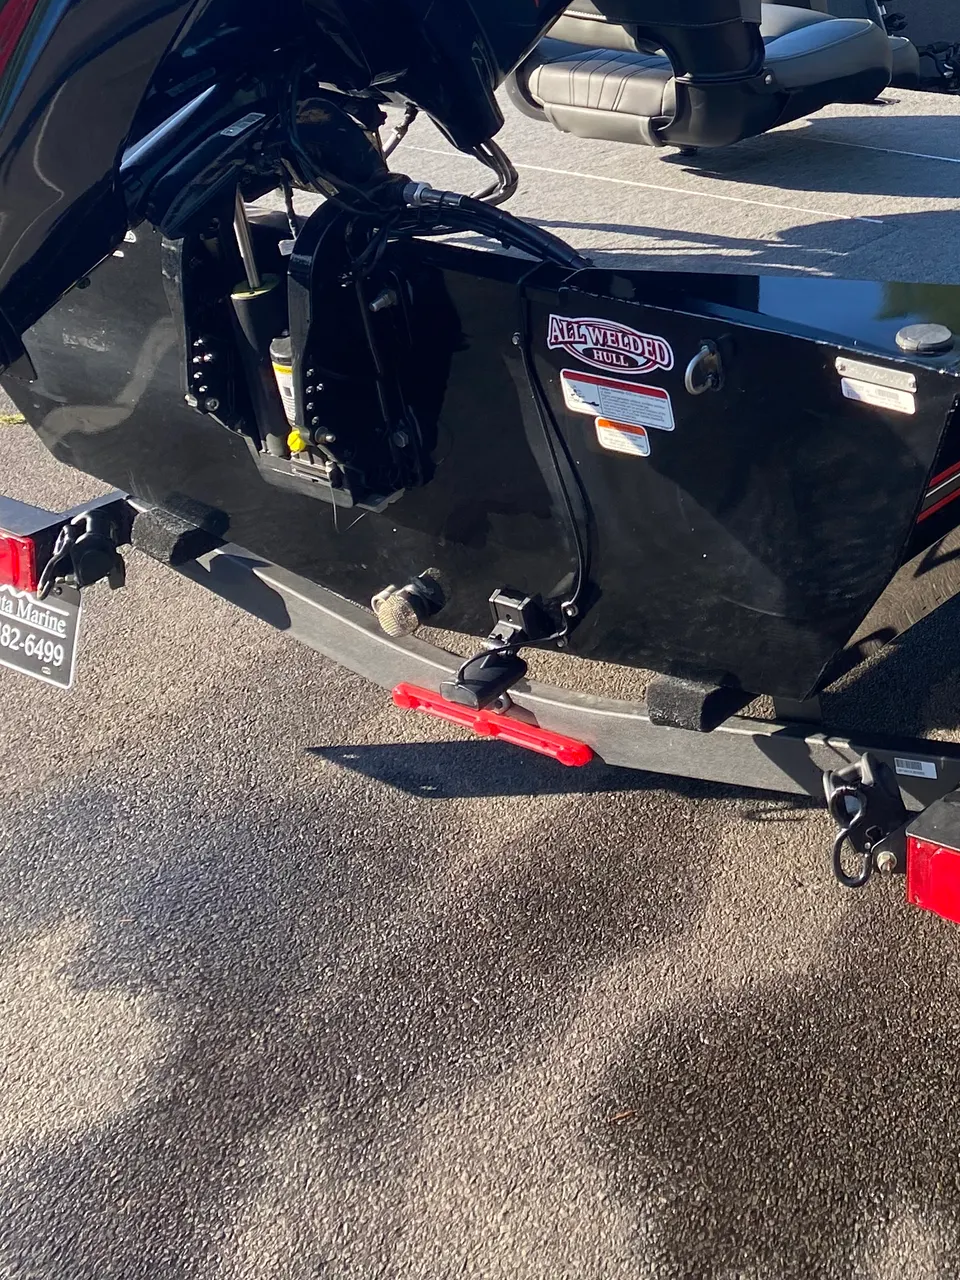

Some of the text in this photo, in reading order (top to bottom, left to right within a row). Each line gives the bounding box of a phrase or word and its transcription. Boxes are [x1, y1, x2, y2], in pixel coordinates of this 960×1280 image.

[550, 320, 669, 366] ALL WELDED
[593, 349, 629, 367] HULL
[0, 595, 67, 633] ta Marine
[0, 623, 65, 667] 82-6499
